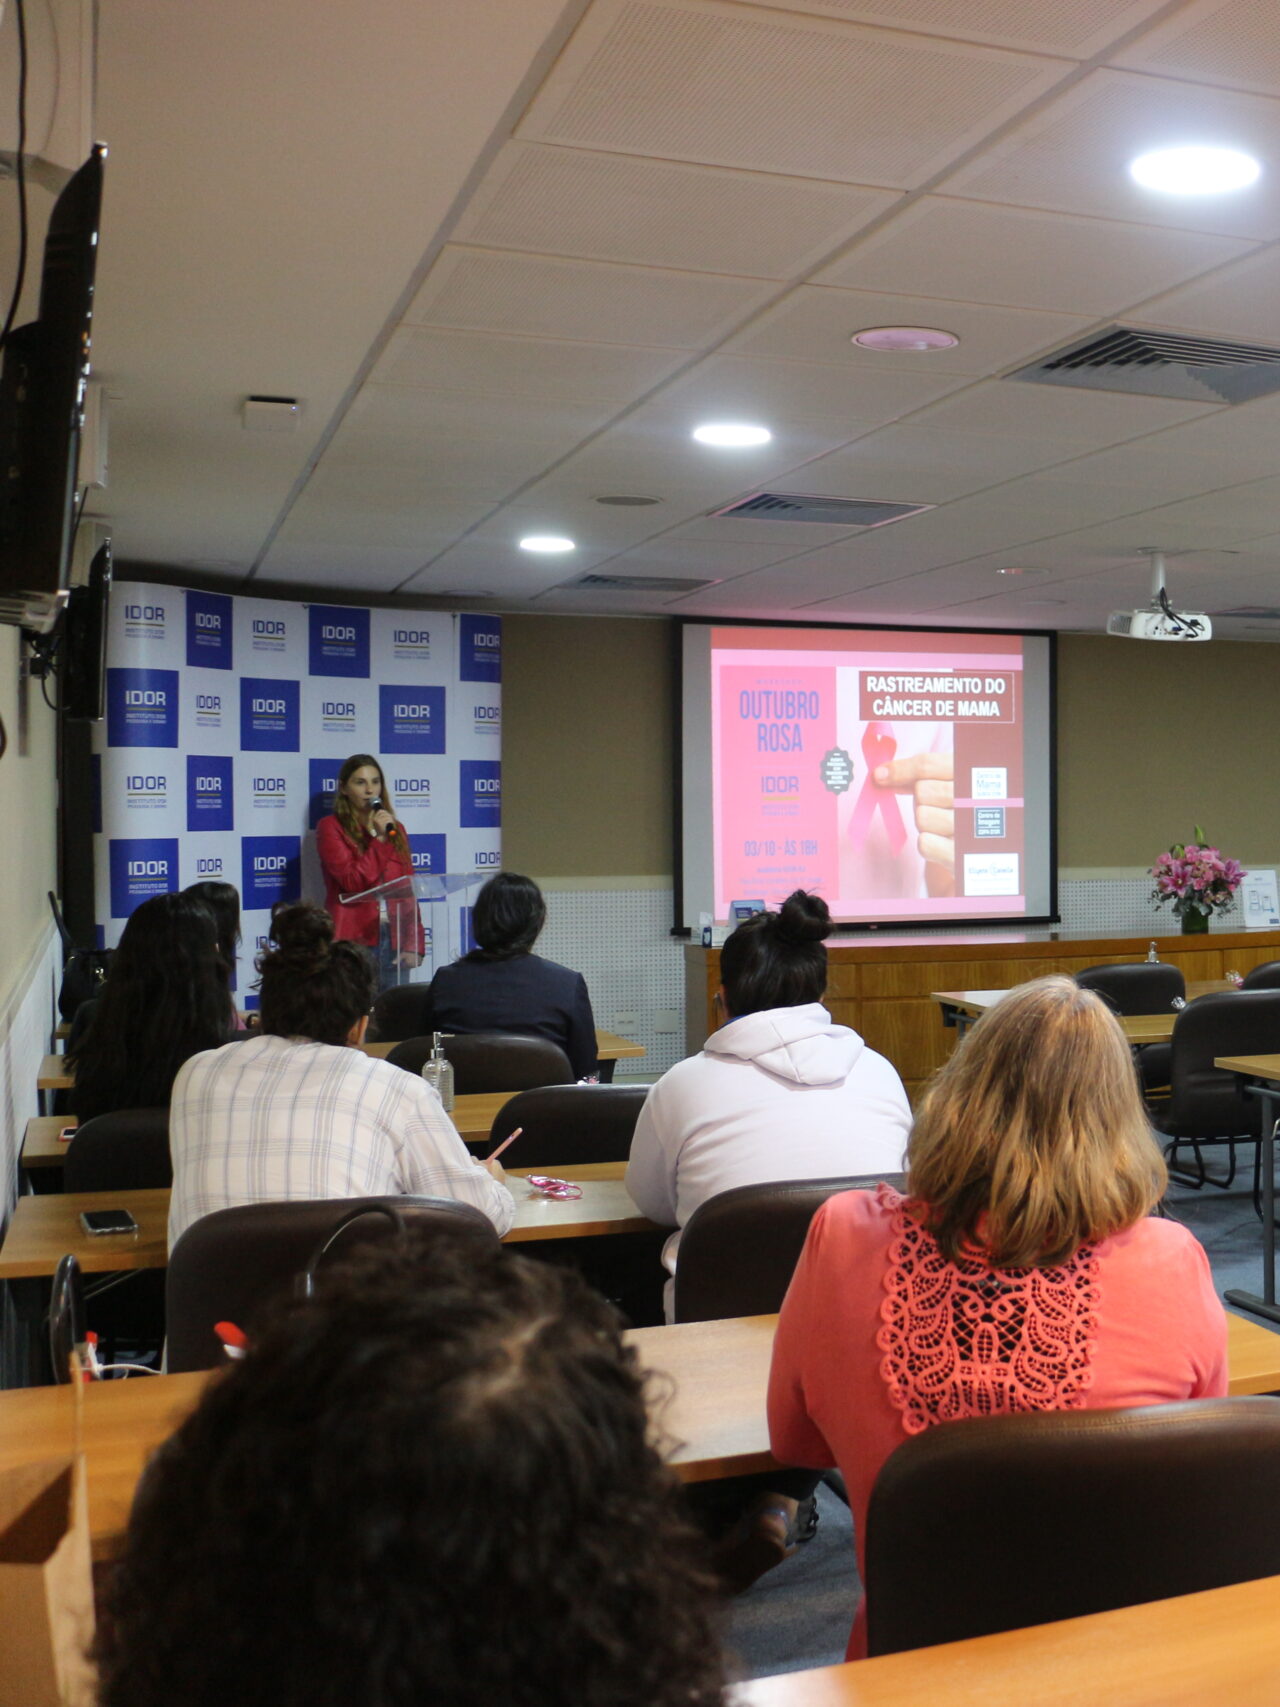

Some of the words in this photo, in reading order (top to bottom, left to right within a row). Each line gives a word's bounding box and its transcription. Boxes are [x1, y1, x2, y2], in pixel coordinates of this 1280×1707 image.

[125, 605, 165, 621] IDOR
[195, 612, 221, 629] IDOR
[252, 619, 286, 635] IDOR
[322, 625, 356, 641] IDOR
[393, 630, 431, 644] IDOR
[866, 675, 983, 694] RASTREAMENTO
[985, 677, 1005, 694] DO
[125, 690, 166, 706] IDOR
[196, 694, 221, 710] IDOR
[252, 699, 286, 713] IDOR
[739, 690, 819, 719] OUTUBRO
[873, 695, 932, 716] CÂNCER
[935, 700, 954, 716] DE
[958, 701, 1000, 717] MAMA
[322, 702, 356, 716] IDOR
[393, 704, 431, 718] IDOR
[757, 723, 803, 752] ROSA
[127, 775, 167, 790] IDOR
[196, 776, 222, 791] IDOR
[253, 777, 286, 792] IDOR
[394, 778, 431, 792] IDOR
[761, 776, 799, 793] IDOR
[197, 858, 223, 873] IDOR
[253, 855, 287, 871] IDOR
[410, 853, 431, 866] OR
[128, 860, 168, 876] IDOR
